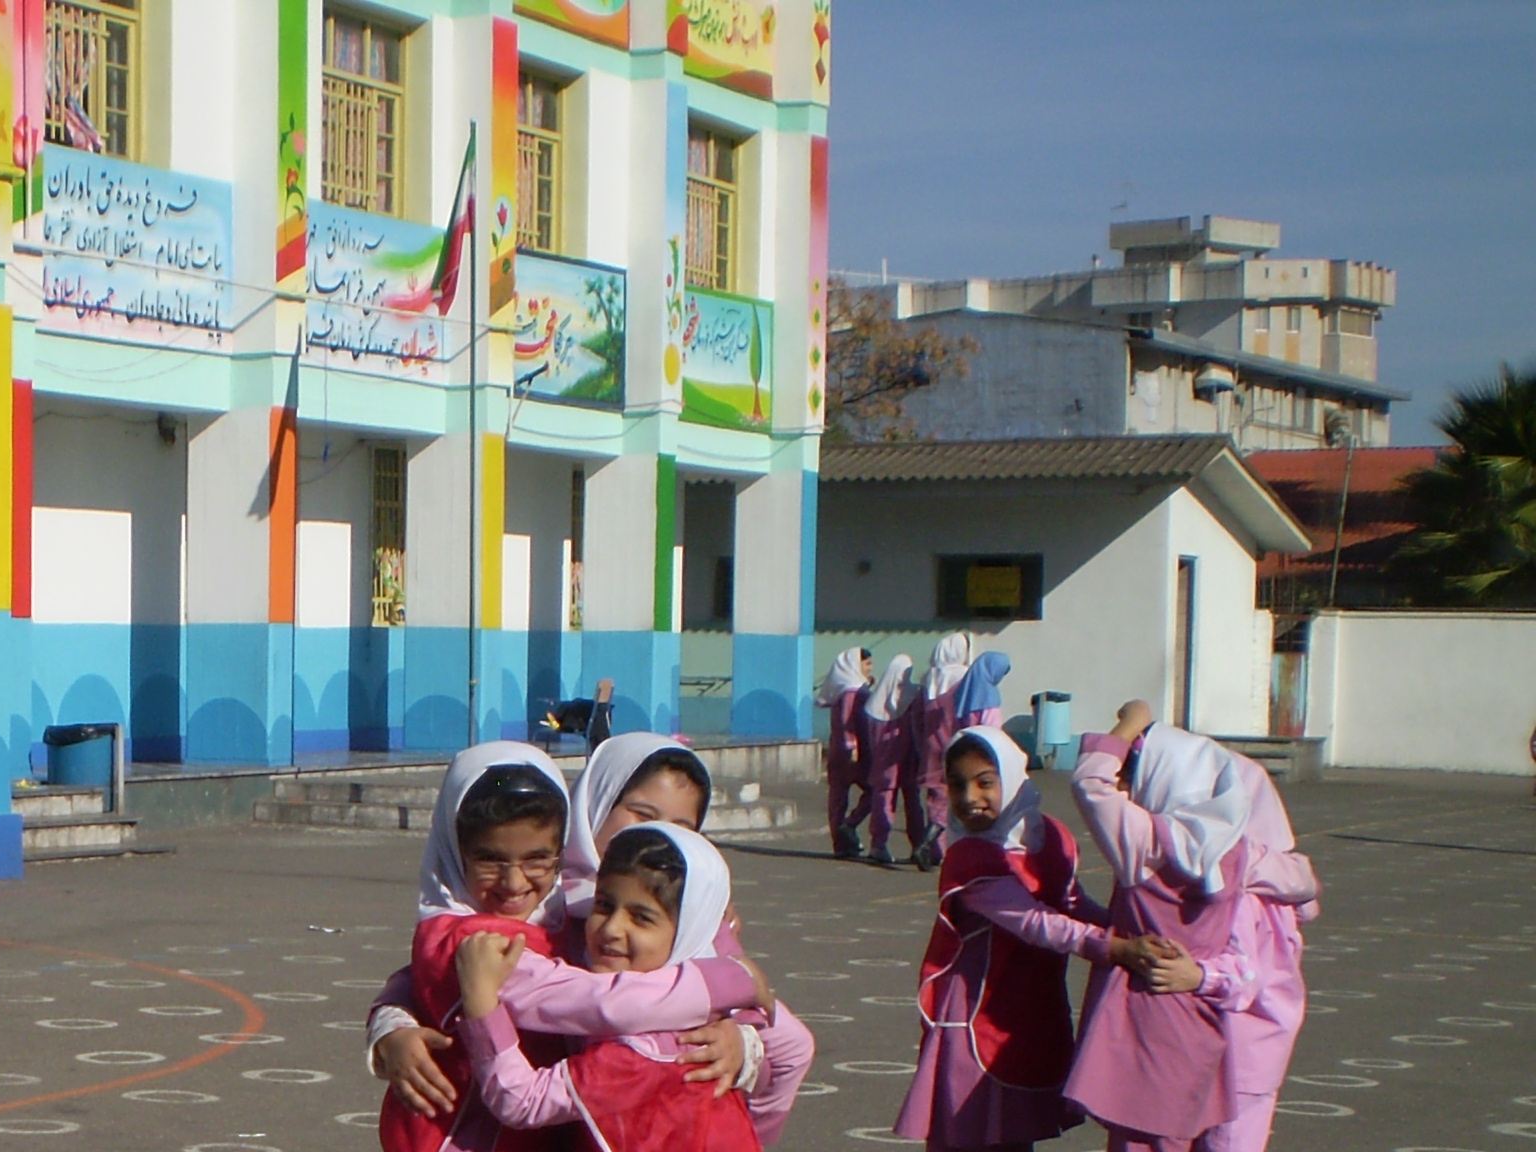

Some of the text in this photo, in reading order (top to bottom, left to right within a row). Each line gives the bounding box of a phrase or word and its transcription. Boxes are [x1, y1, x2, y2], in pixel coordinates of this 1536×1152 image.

[47, 164, 92, 212] باوران
[96, 170, 114, 215] حق
[142, 177, 198, 227] فروغ
[76, 226, 109, 258] آزادی
[155, 237, 180, 280] امام
